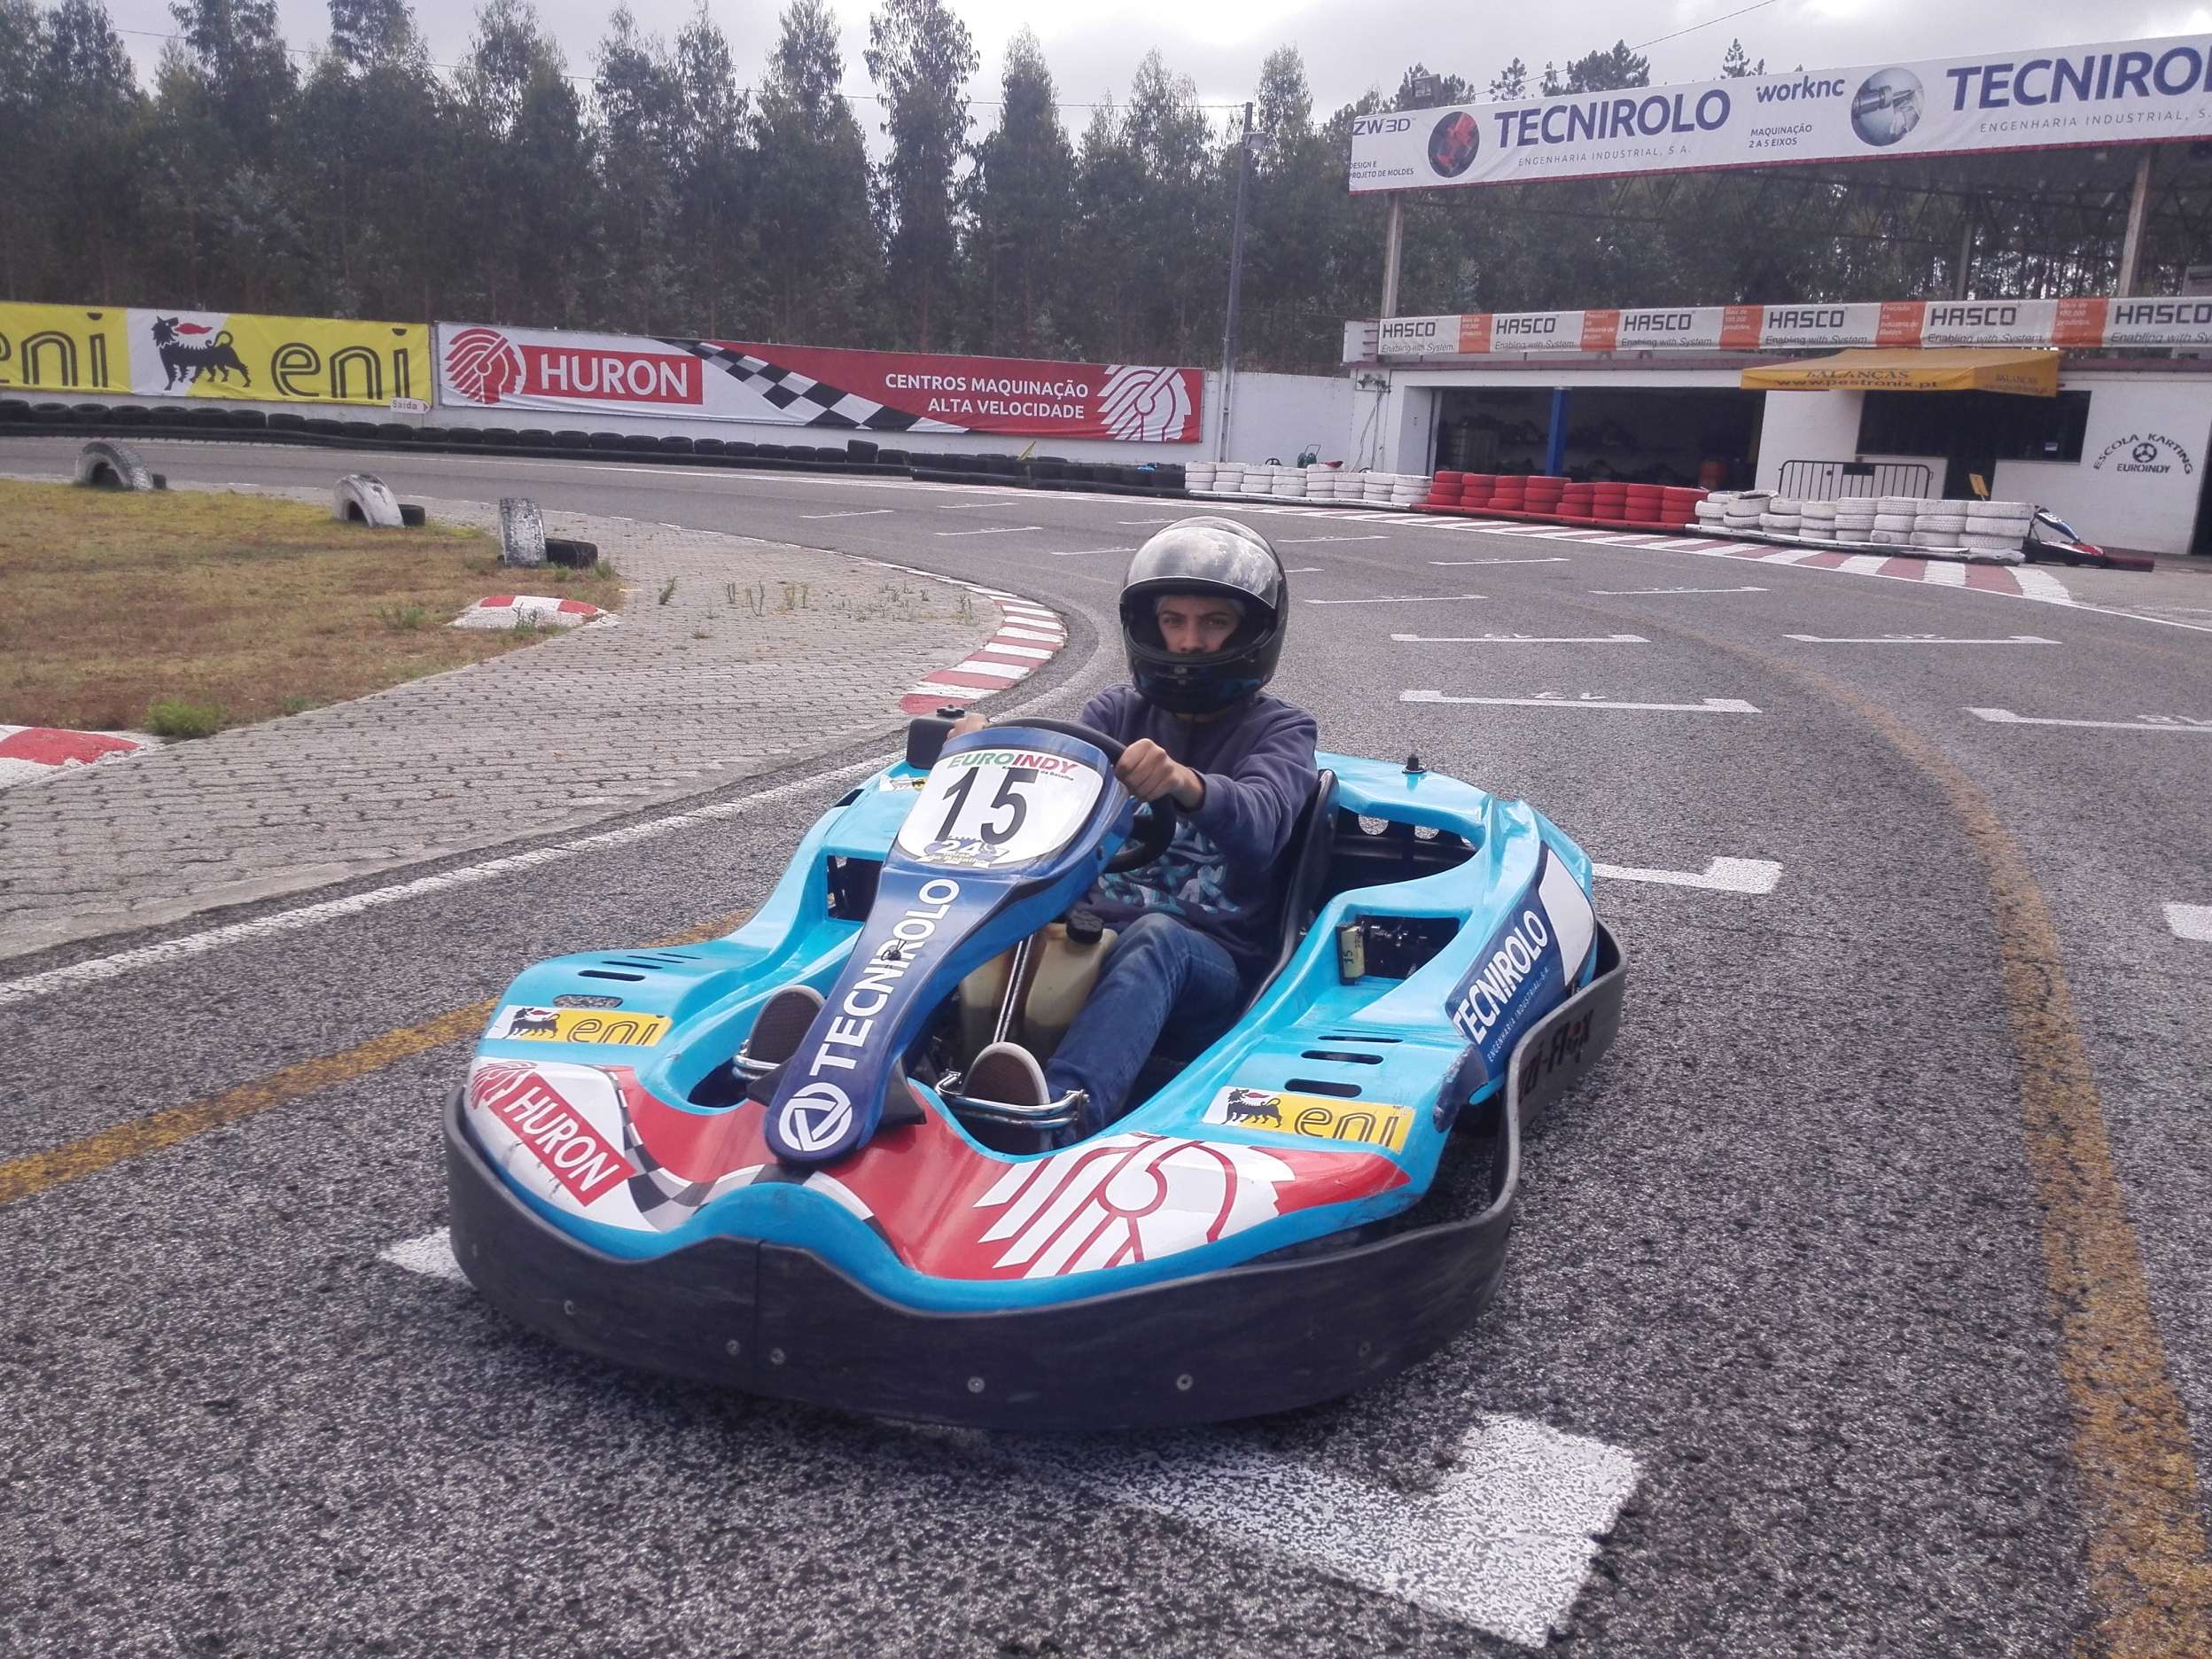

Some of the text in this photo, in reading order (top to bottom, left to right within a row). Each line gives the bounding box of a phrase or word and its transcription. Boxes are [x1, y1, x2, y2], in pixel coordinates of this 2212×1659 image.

[1494, 89, 1731, 148] TECNIROLO
[1980, 117, 2077, 133] ENGENHARIA
[1750, 123, 1812, 136] MAQUINAÇÃO
[1772, 137, 1798, 147] EIXOS
[1518, 153, 1587, 167] ENGENHARIA
[1388, 167, 1414, 176] MOLDES
[1624, 314, 1692, 331] HASCO
[1768, 310, 1845, 329] HASCO
[1930, 307, 2016, 326] HASCO
[2115, 303, 2212, 324] HASCO
[1382, 322, 1436, 338] HASCO
[1496, 318, 1556, 334] HASCO
[1427, 342, 1453, 352] System
[1546, 339, 1575, 348] System
[1678, 337, 1712, 347] System
[1831, 334, 1867, 346] System
[2000, 333, 2042, 344] System
[0, 312, 109, 388] ni
[270, 328, 410, 400] eni
[541, 354, 688, 398] HURON
[885, 373, 1088, 400] CENTROS MAQUINAÇÃO
[928, 397, 1085, 419] ALTA VELOCIDADE
[2093, 433, 2193, 474] ESCOLA KARTING
[2116, 463, 2171, 474] EUROINDY
[947, 752, 1079, 774] EUROINDY
[934, 766, 1040, 845] 15
[810, 878, 960, 1076] TECNIROLO
[1453, 910, 1548, 1045] TECNIROLO
[566, 1015, 666, 1046] eni
[1487, 1017, 1515, 1063] ENGENHARIA
[1294, 1105, 1405, 1148] eni
[502, 1086, 620, 1192] HURON
